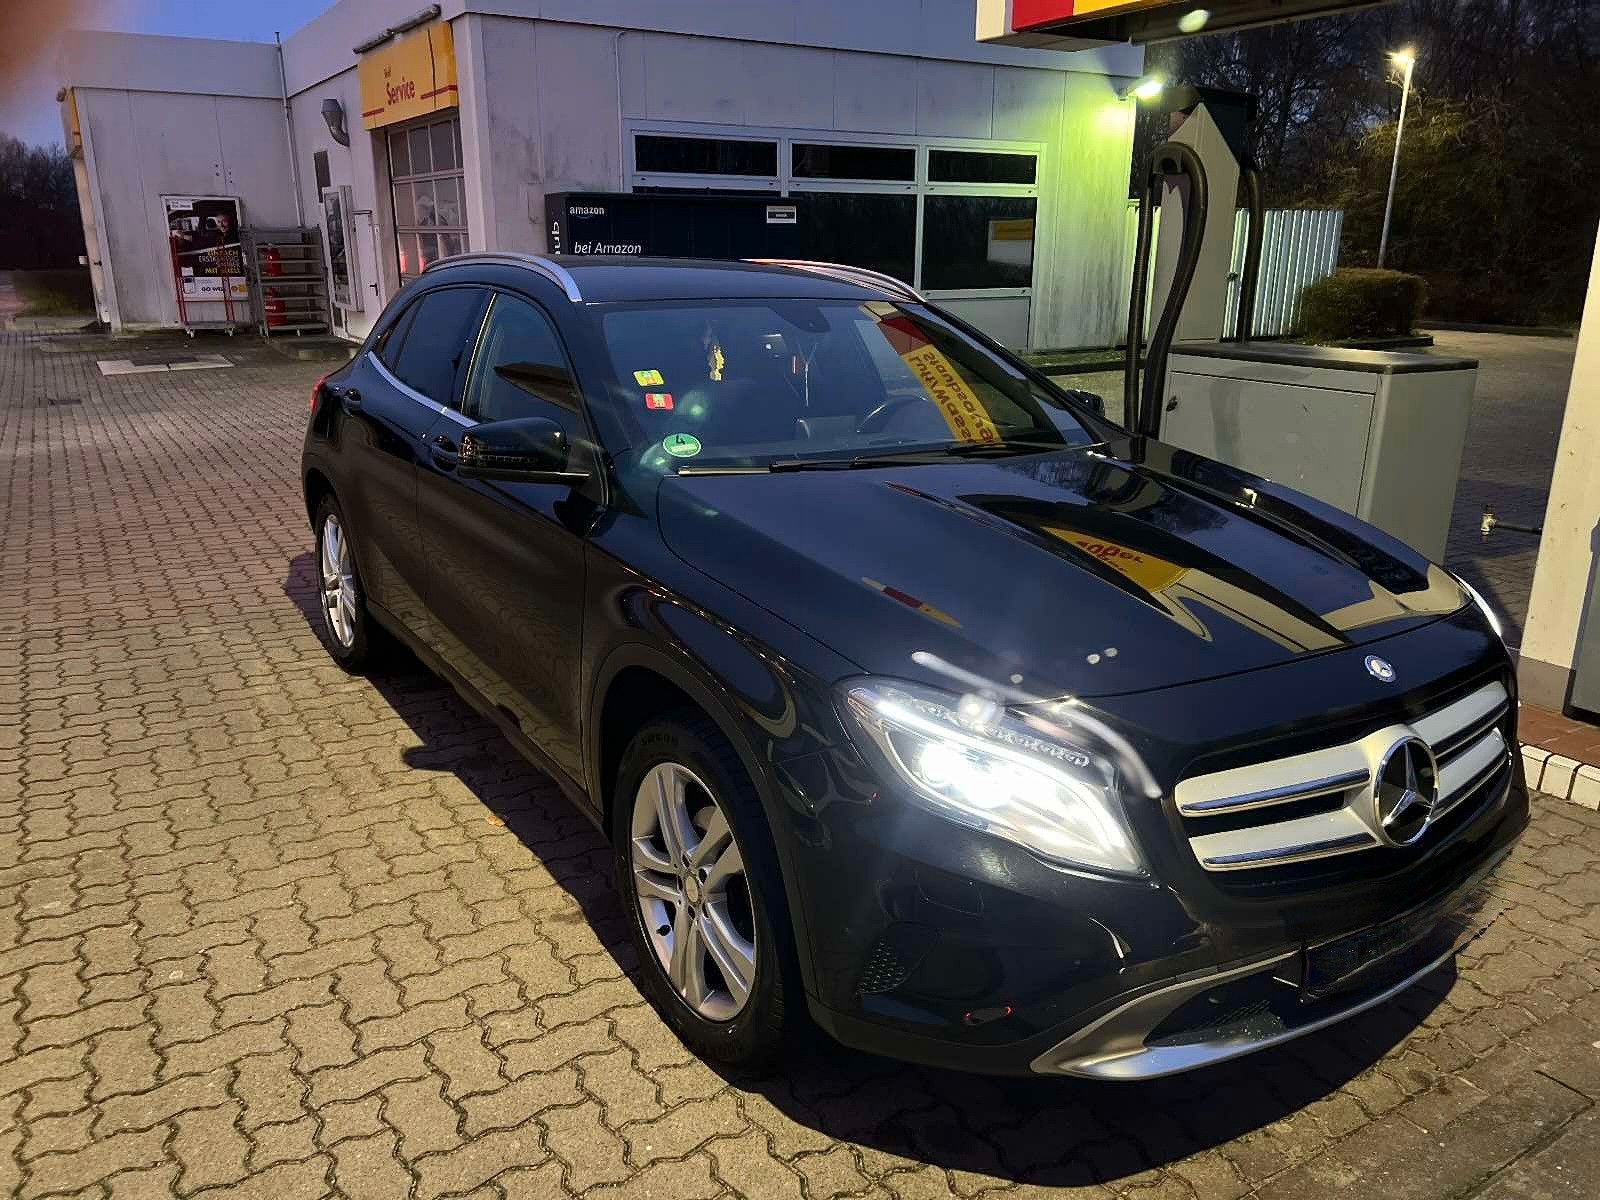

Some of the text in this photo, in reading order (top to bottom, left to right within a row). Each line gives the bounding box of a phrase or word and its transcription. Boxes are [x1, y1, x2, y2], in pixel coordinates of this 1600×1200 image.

[386, 76, 416, 106] Service
[569, 206, 605, 216] amazon
[574, 241, 642, 254] bei Amazon
[676, 434, 685, 445] 4
